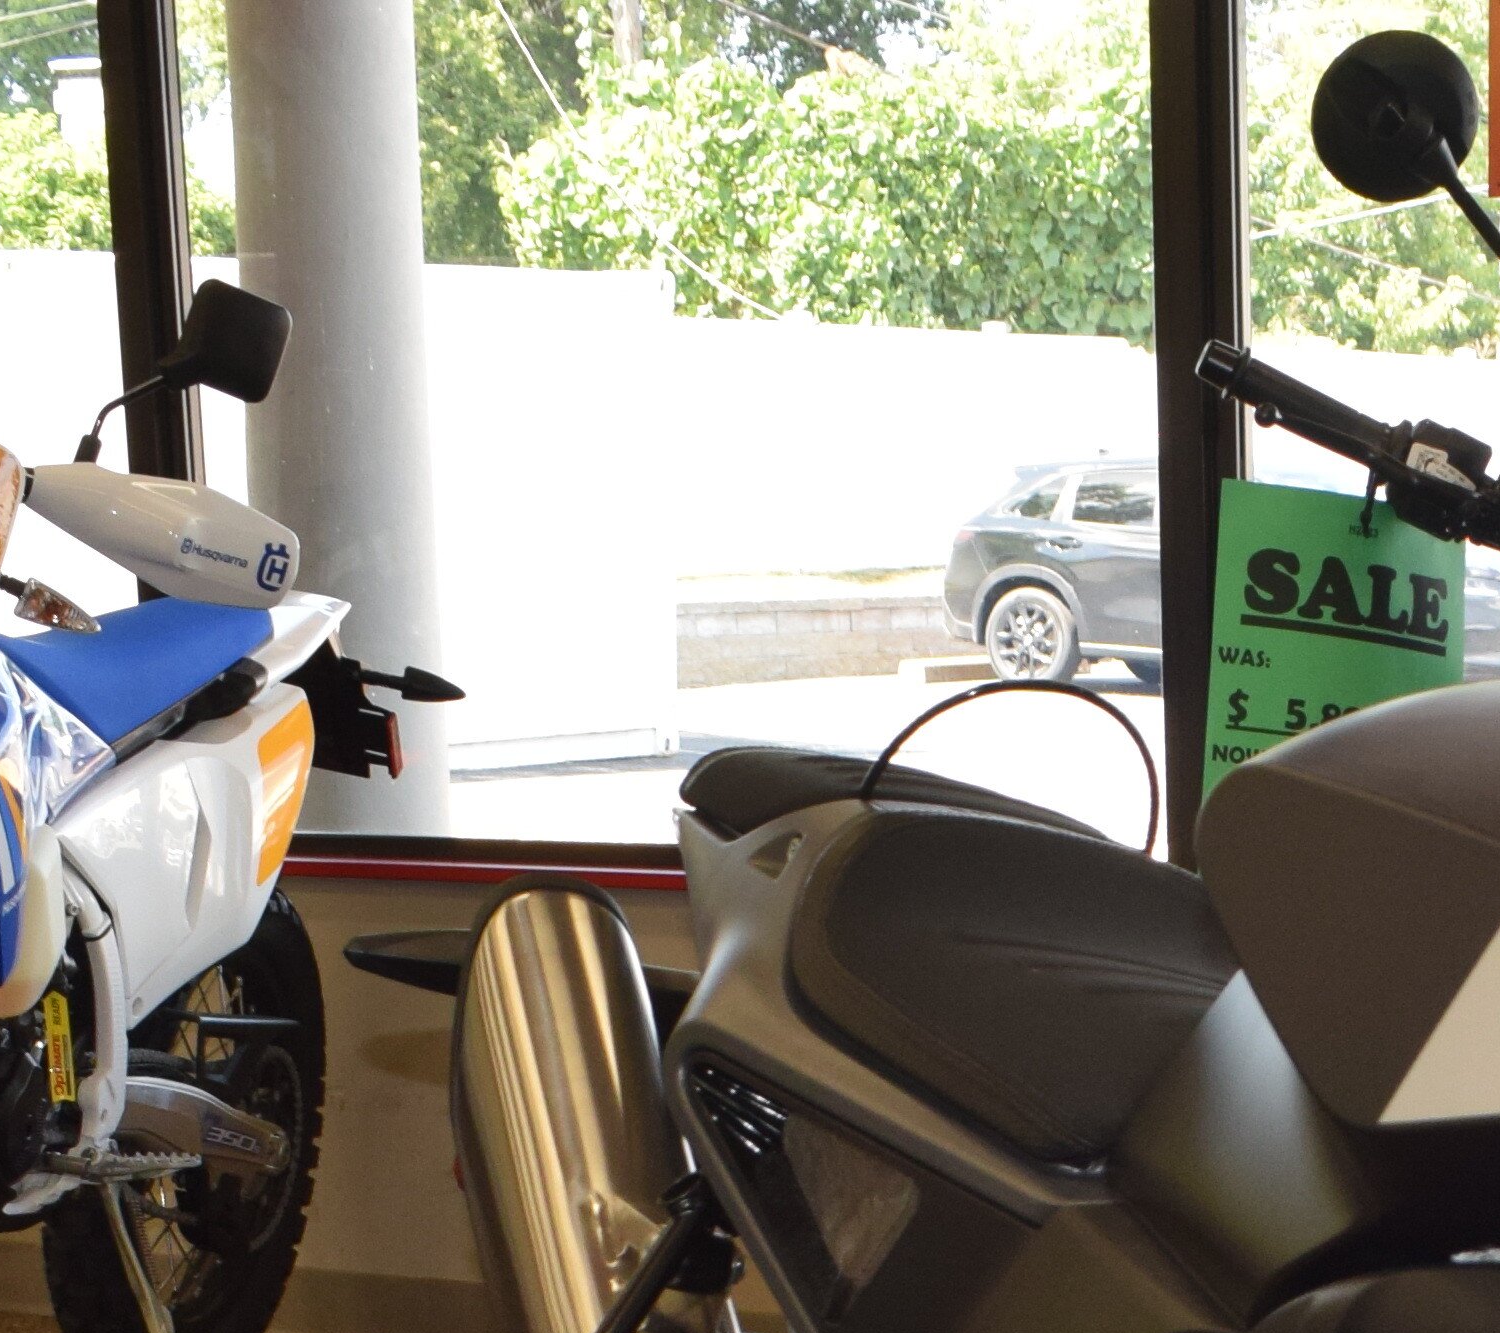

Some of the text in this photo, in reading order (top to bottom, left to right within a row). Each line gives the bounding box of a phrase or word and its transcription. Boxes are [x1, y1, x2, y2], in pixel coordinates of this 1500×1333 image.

[192, 543, 249, 569] Husqvarna
[1243, 547, 1449, 643] SALE
[1218, 645, 1271, 668] WAS:
